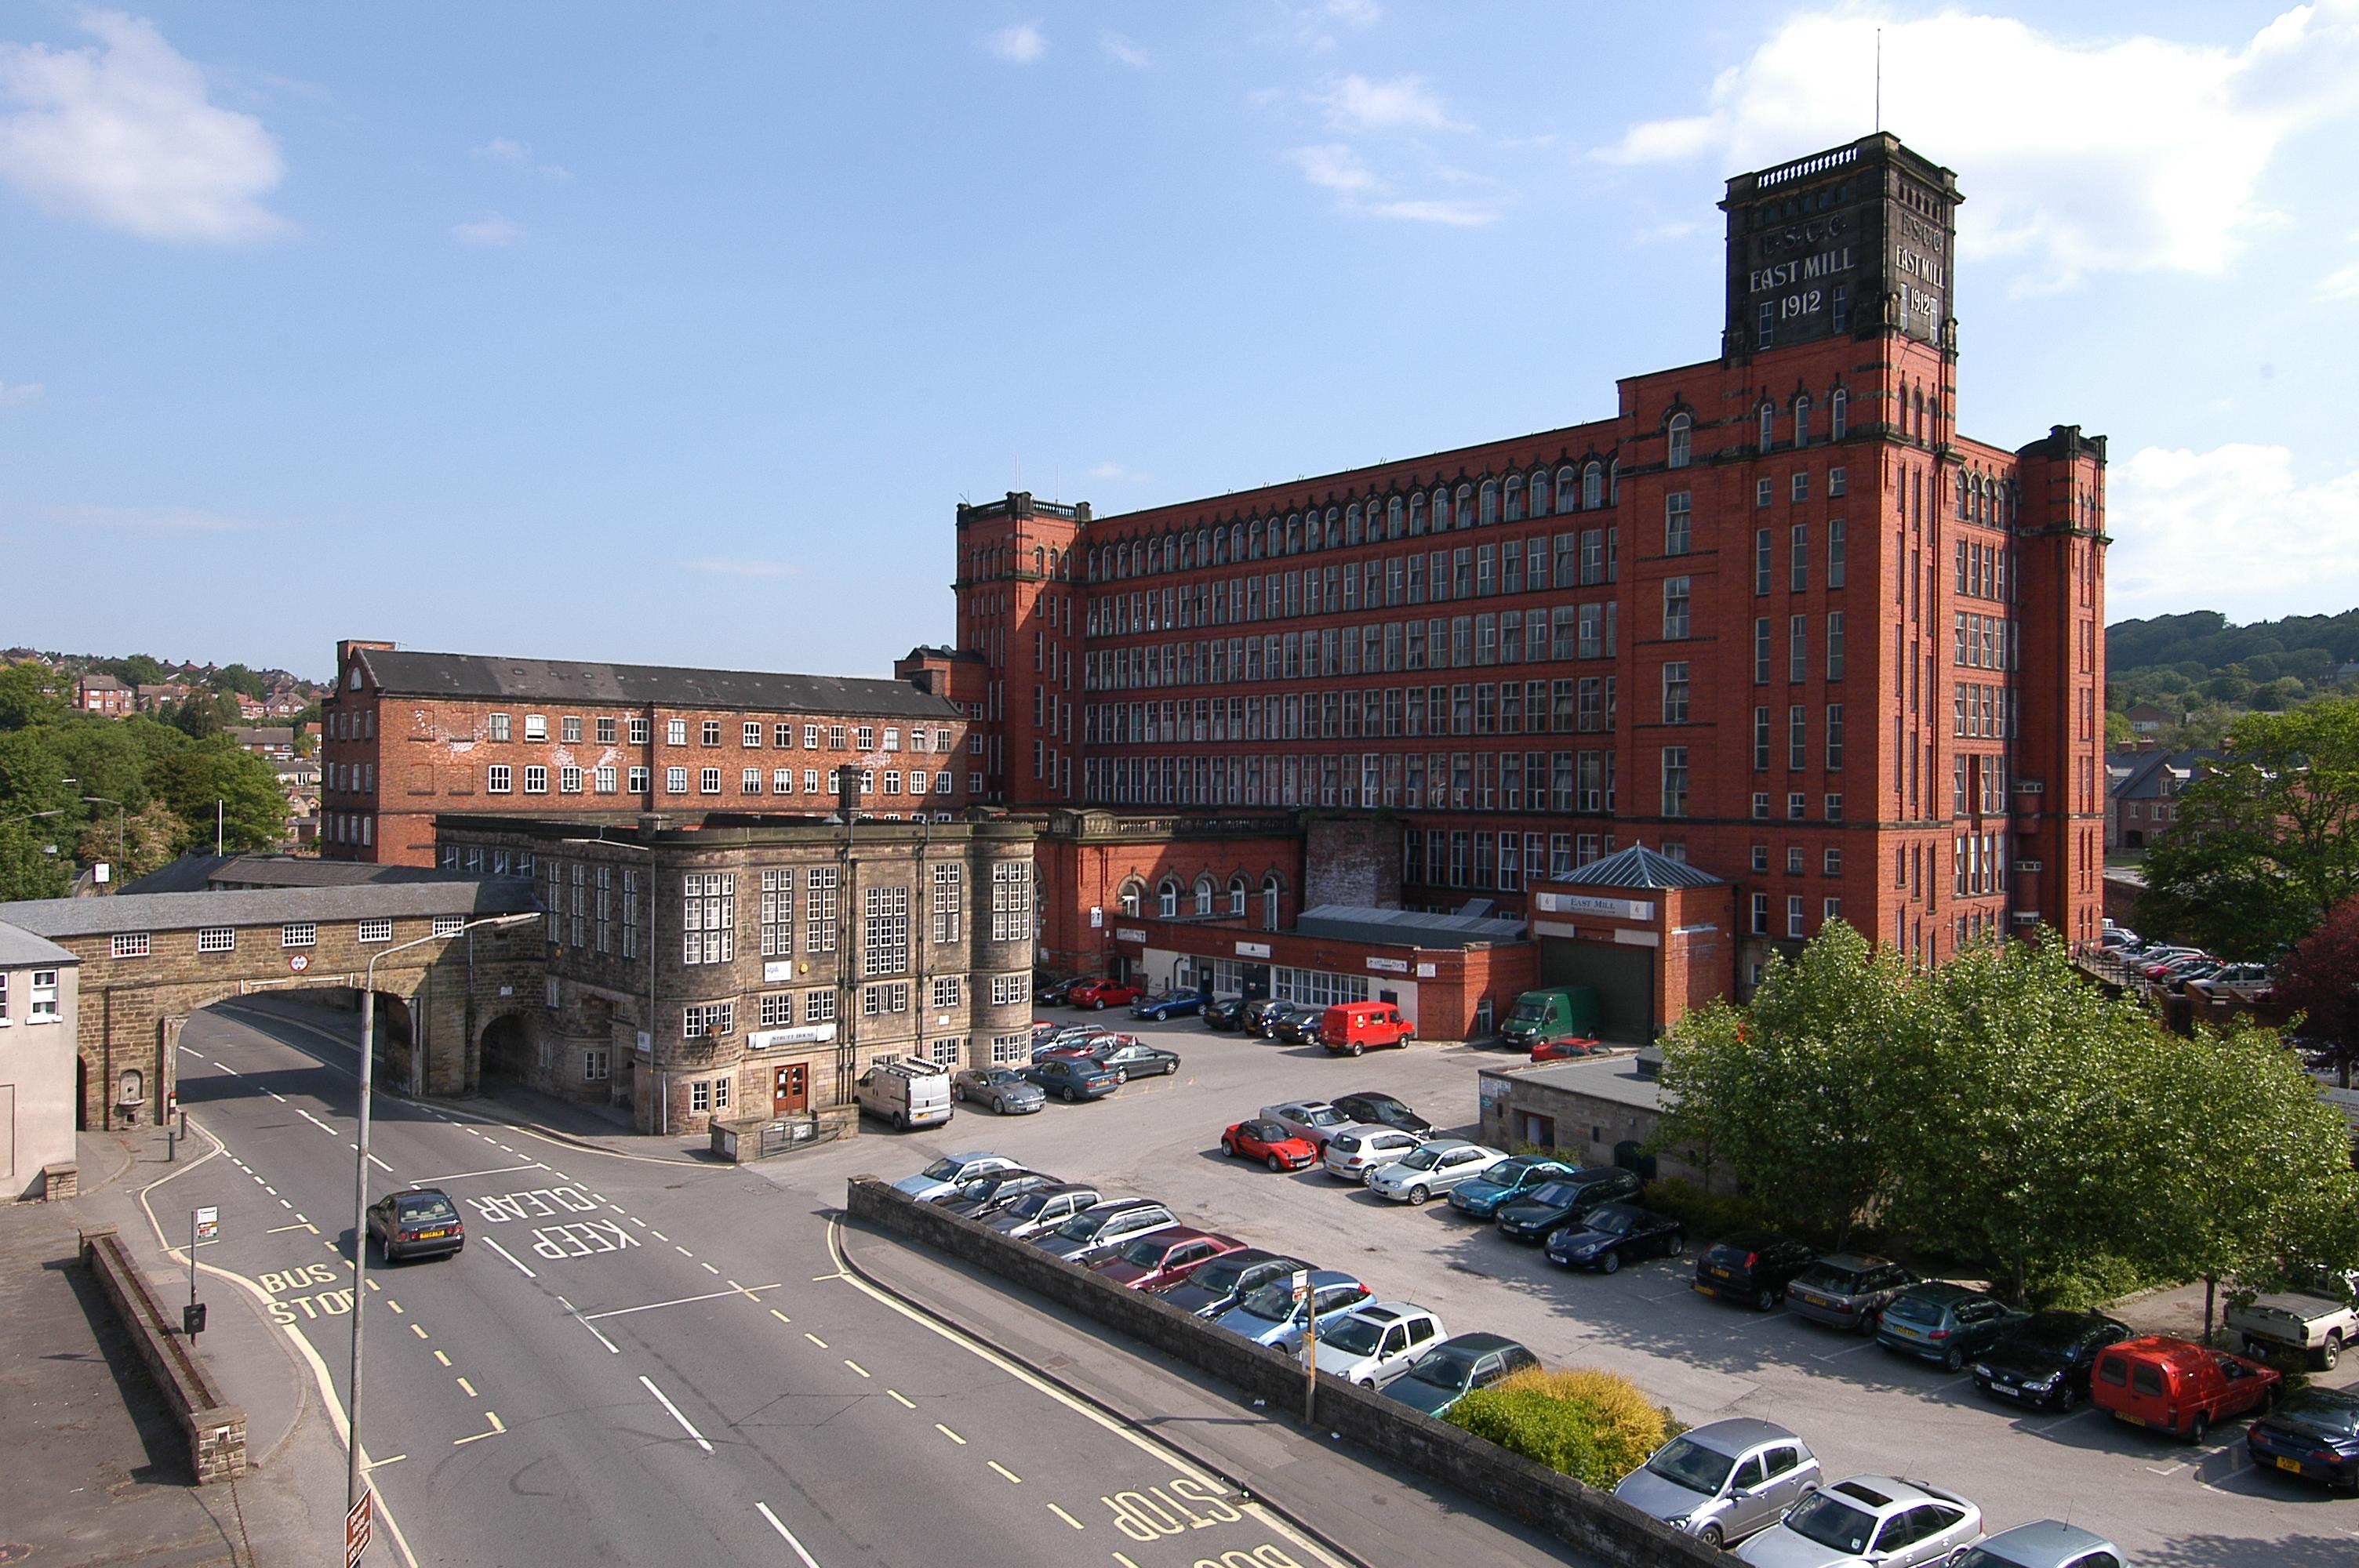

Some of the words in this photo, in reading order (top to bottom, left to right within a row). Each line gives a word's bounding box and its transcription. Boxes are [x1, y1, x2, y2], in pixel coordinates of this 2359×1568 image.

[1750, 261, 1799, 293] EAST
[1803, 247, 1856, 280] MILL
[1896, 245, 1921, 277] EAST
[1921, 257, 1945, 289] MILL
[1781, 289, 1822, 319] 1912
[1910, 288, 1930, 317] 1912
[465, 1187, 598, 1223] CLEAR
[532, 1218, 642, 1260] KEEP
[258, 1263, 338, 1294] BUS
[1100, 1479, 1242, 1541] STOP
